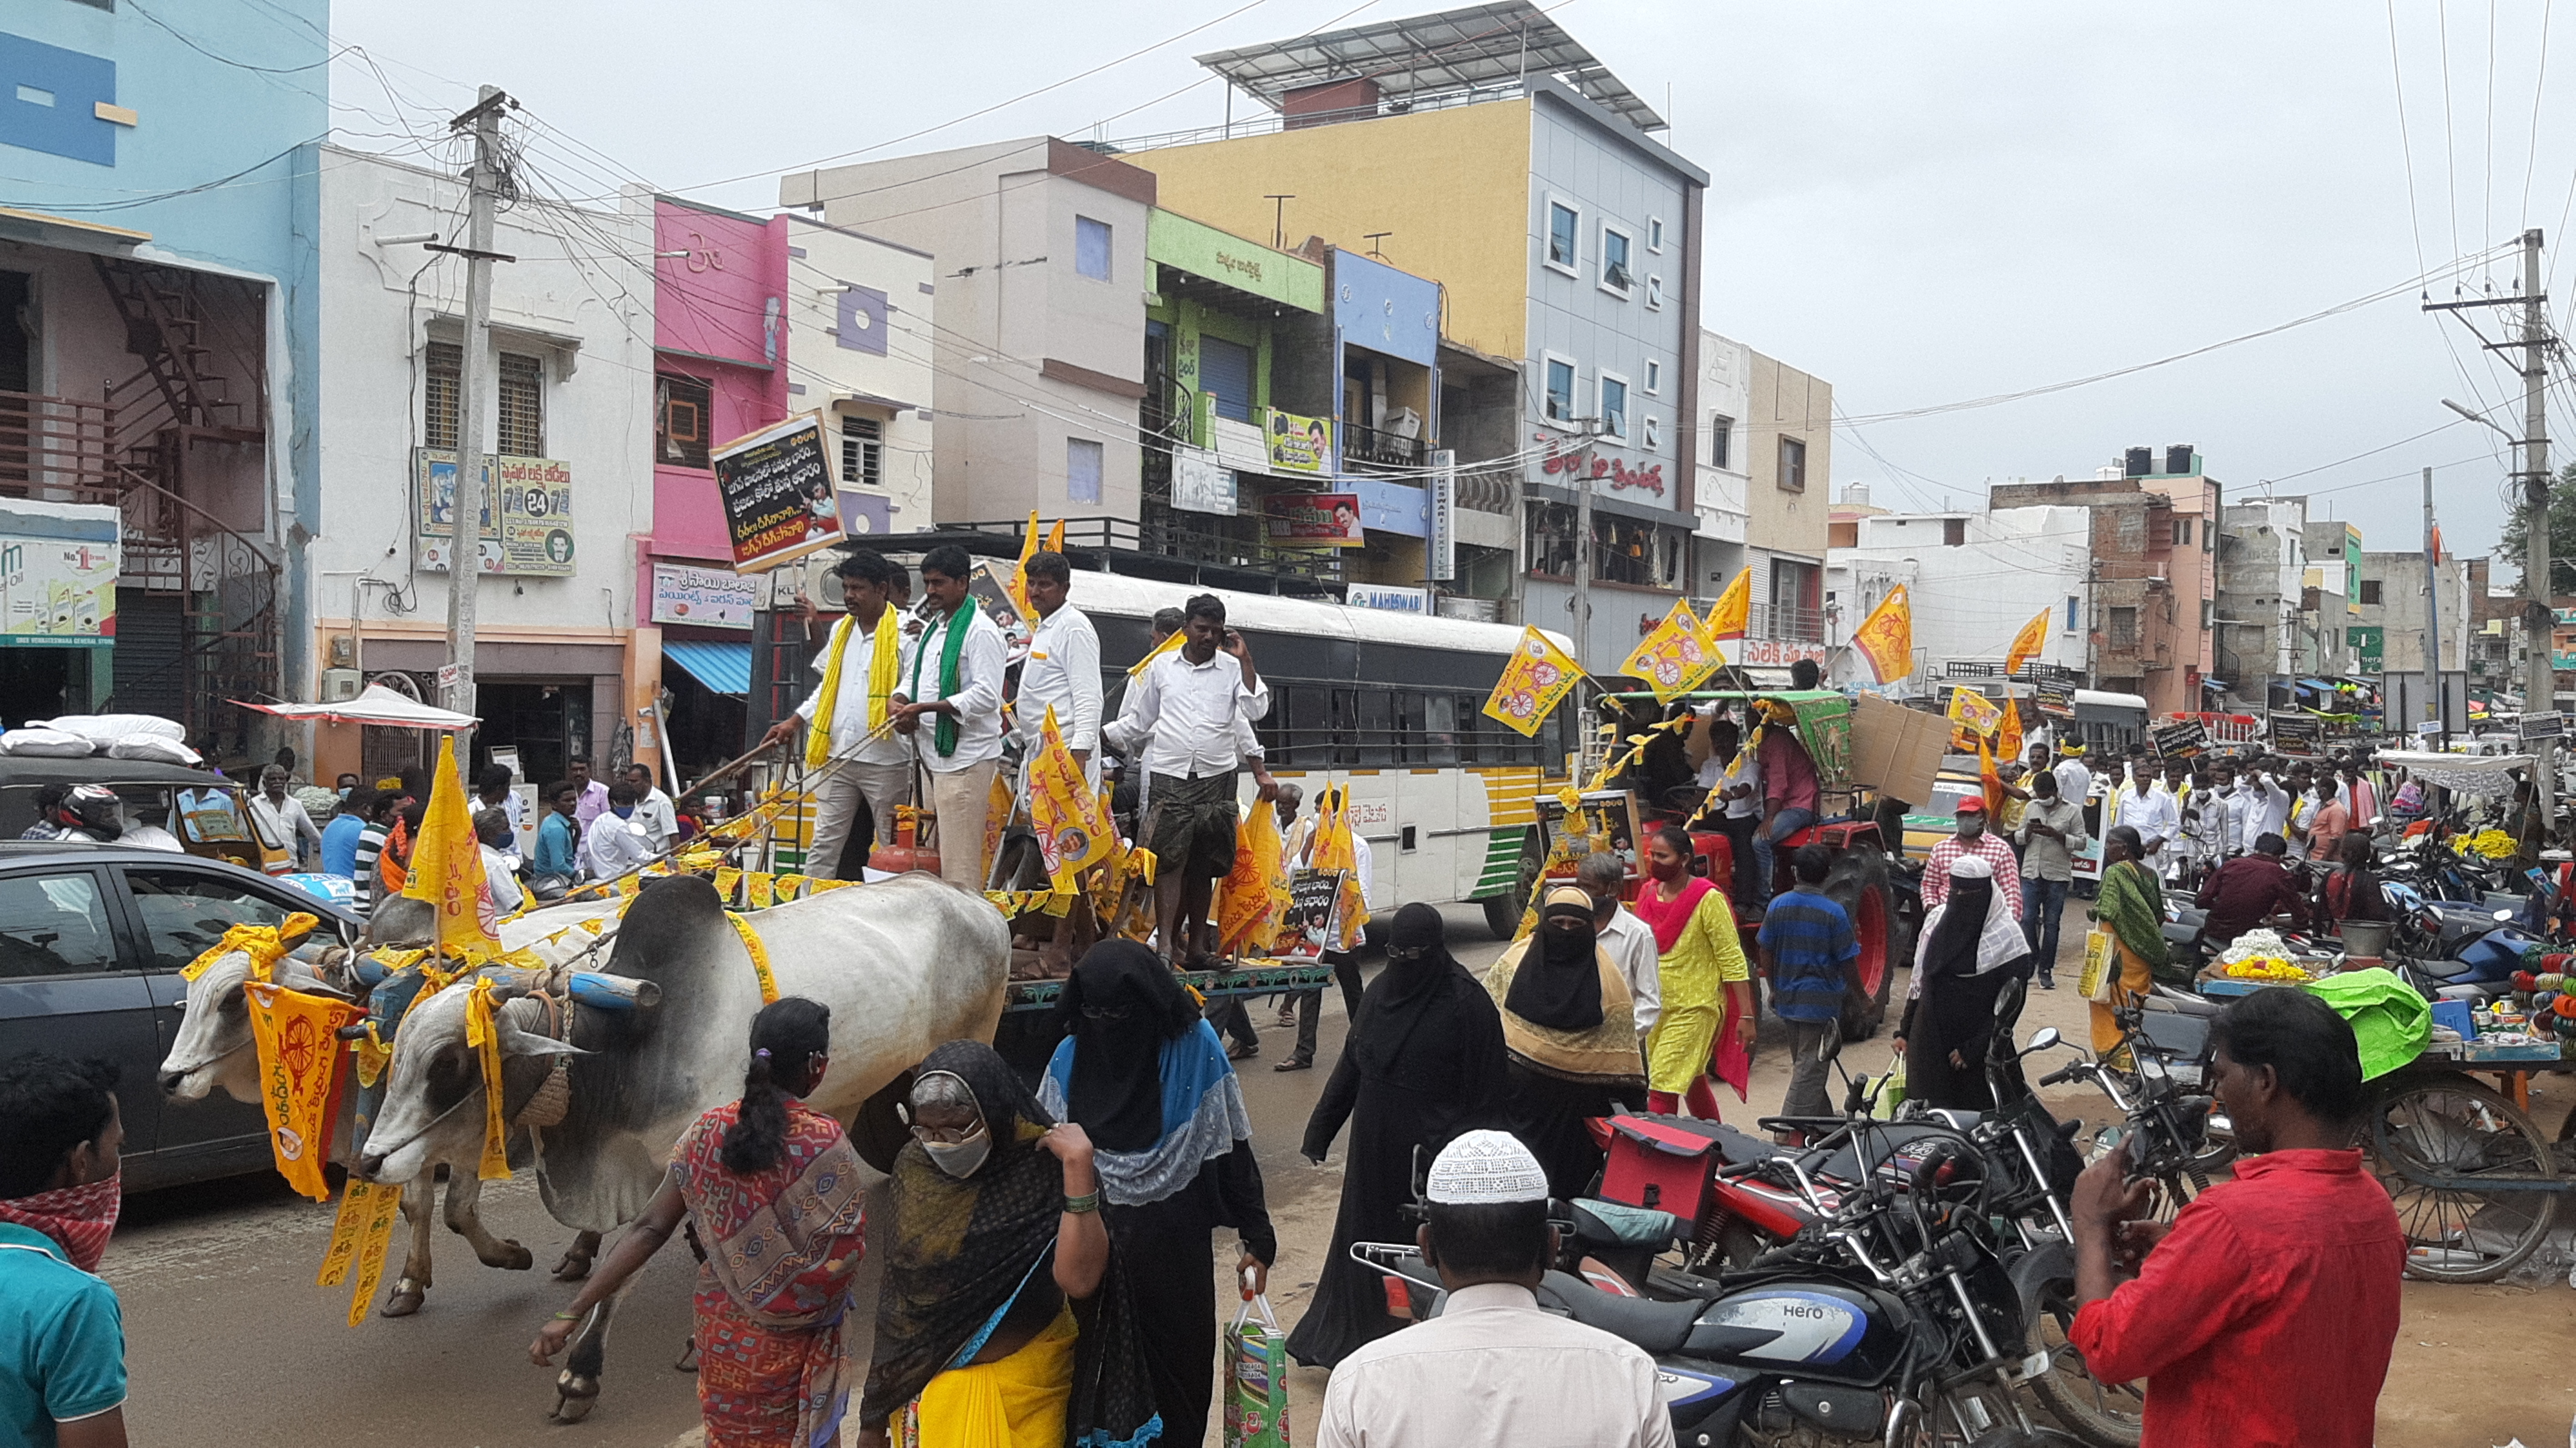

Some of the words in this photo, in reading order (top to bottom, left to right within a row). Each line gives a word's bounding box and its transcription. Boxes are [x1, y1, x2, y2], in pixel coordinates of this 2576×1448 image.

[528, 493, 546, 513] 24
[64, 552, 78, 561] No.
[75, 546, 93, 570] 1
[1437, 526, 1446, 578] TEXTILES
[10, 571, 23, 586] Oil
[1369, 592, 1422, 611] MAHESWARI
[1053, 749, 1101, 837] తెలుగుదేశం
[1783, 1305, 1824, 1320] Hero
